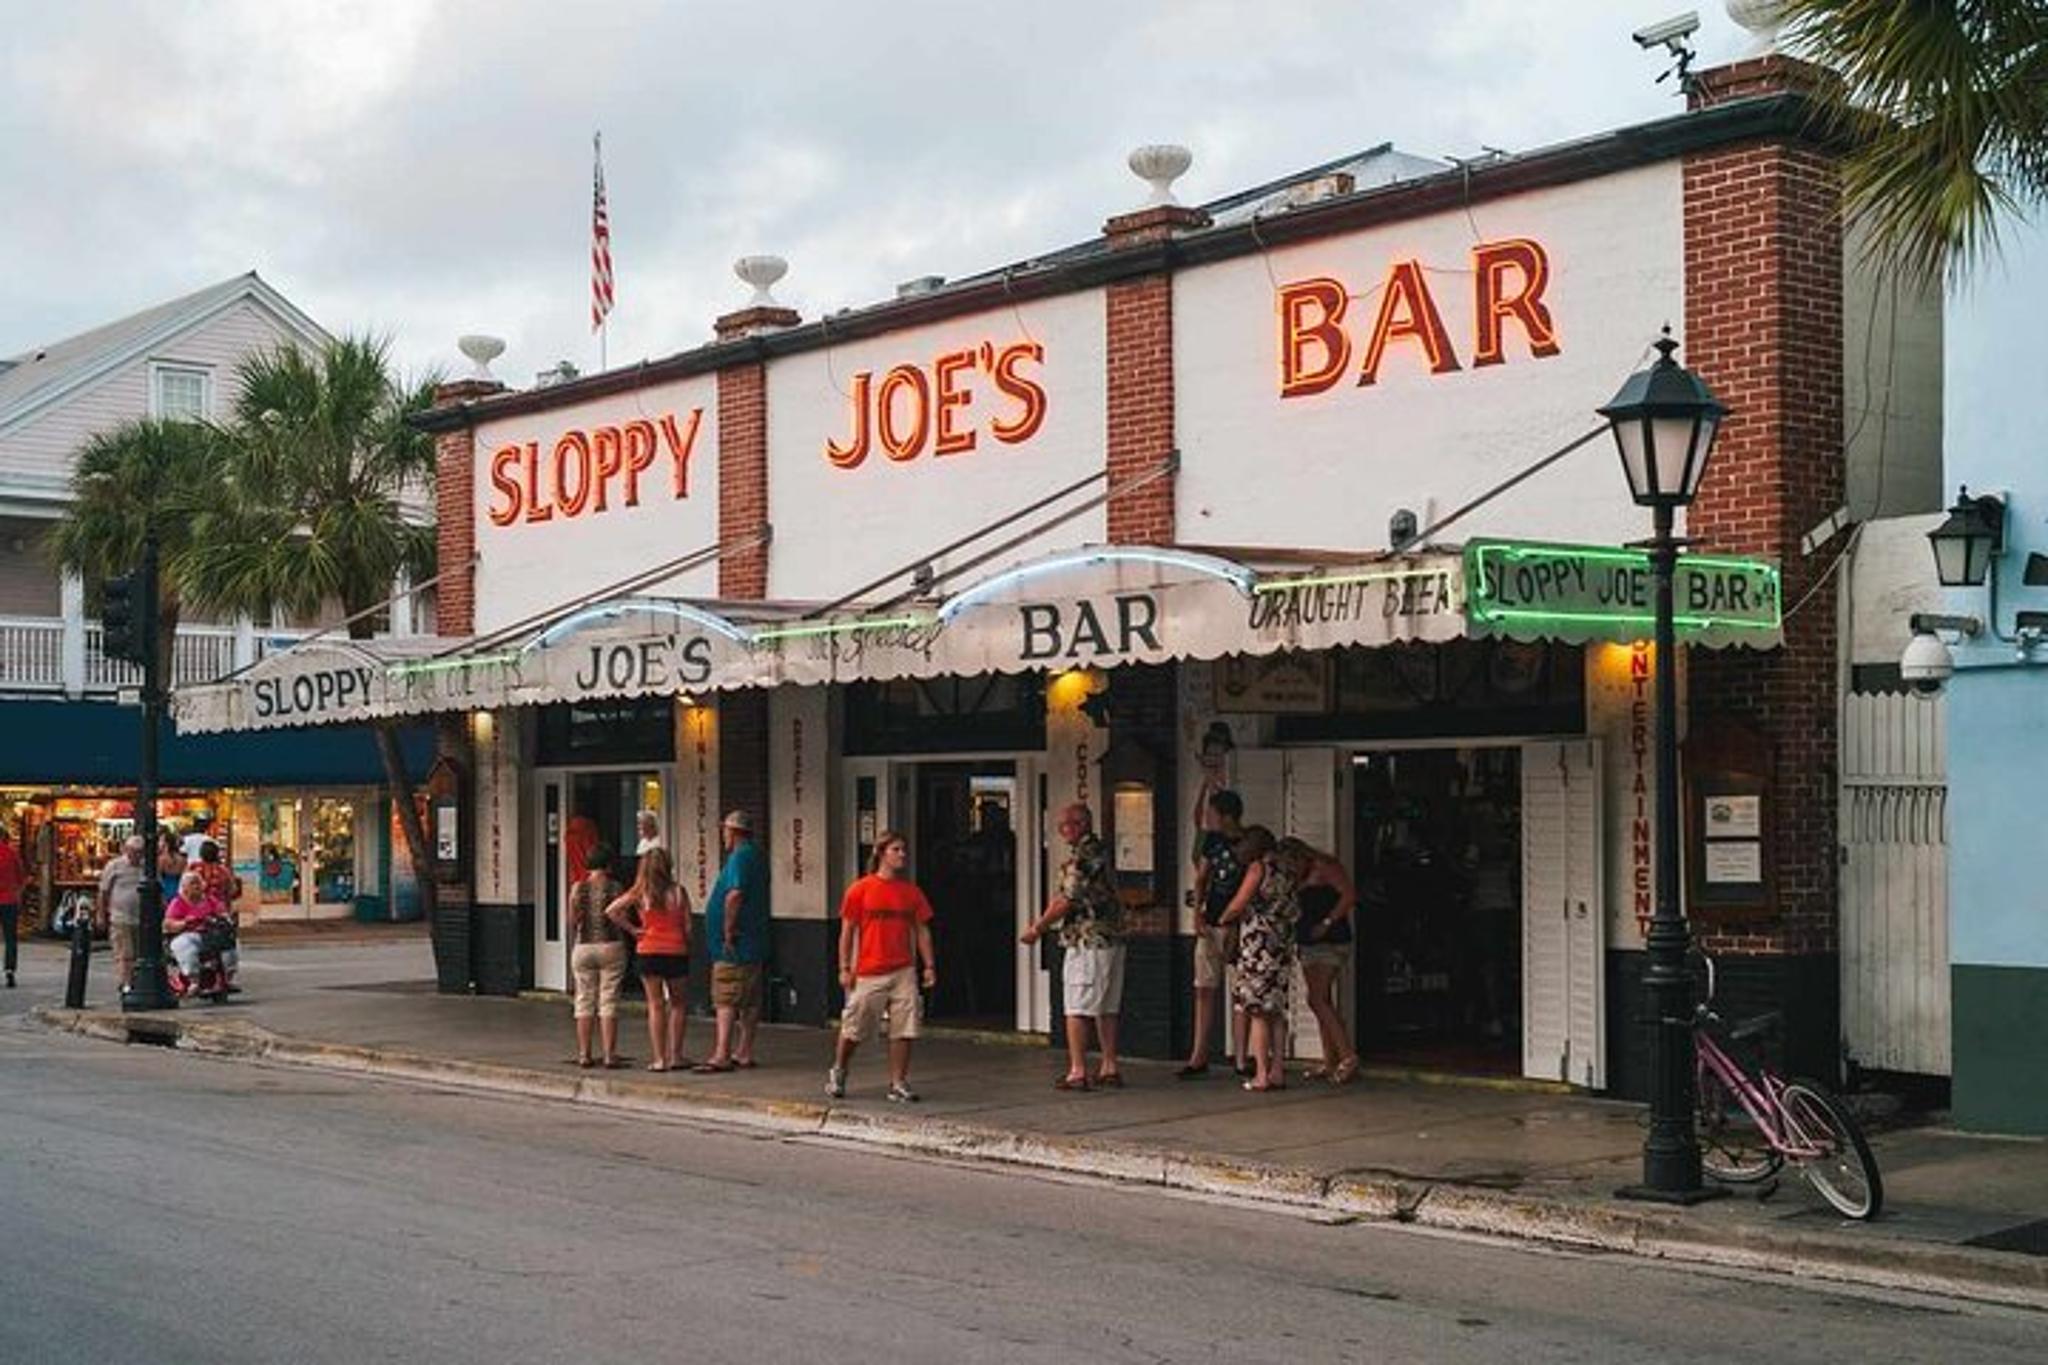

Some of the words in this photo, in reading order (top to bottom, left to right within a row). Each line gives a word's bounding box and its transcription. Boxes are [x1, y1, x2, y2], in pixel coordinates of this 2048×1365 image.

[488, 408, 704, 528] SLOPPY
[827, 341, 1047, 469] JOE'S
[1279, 238, 1561, 399] BAR
[1482, 556, 1586, 607] SLOPPY
[1688, 570, 1749, 611] BAR
[254, 666, 375, 718] SLOPPY
[576, 634, 712, 691] JOE'S
[1019, 594, 1164, 660] BAR
